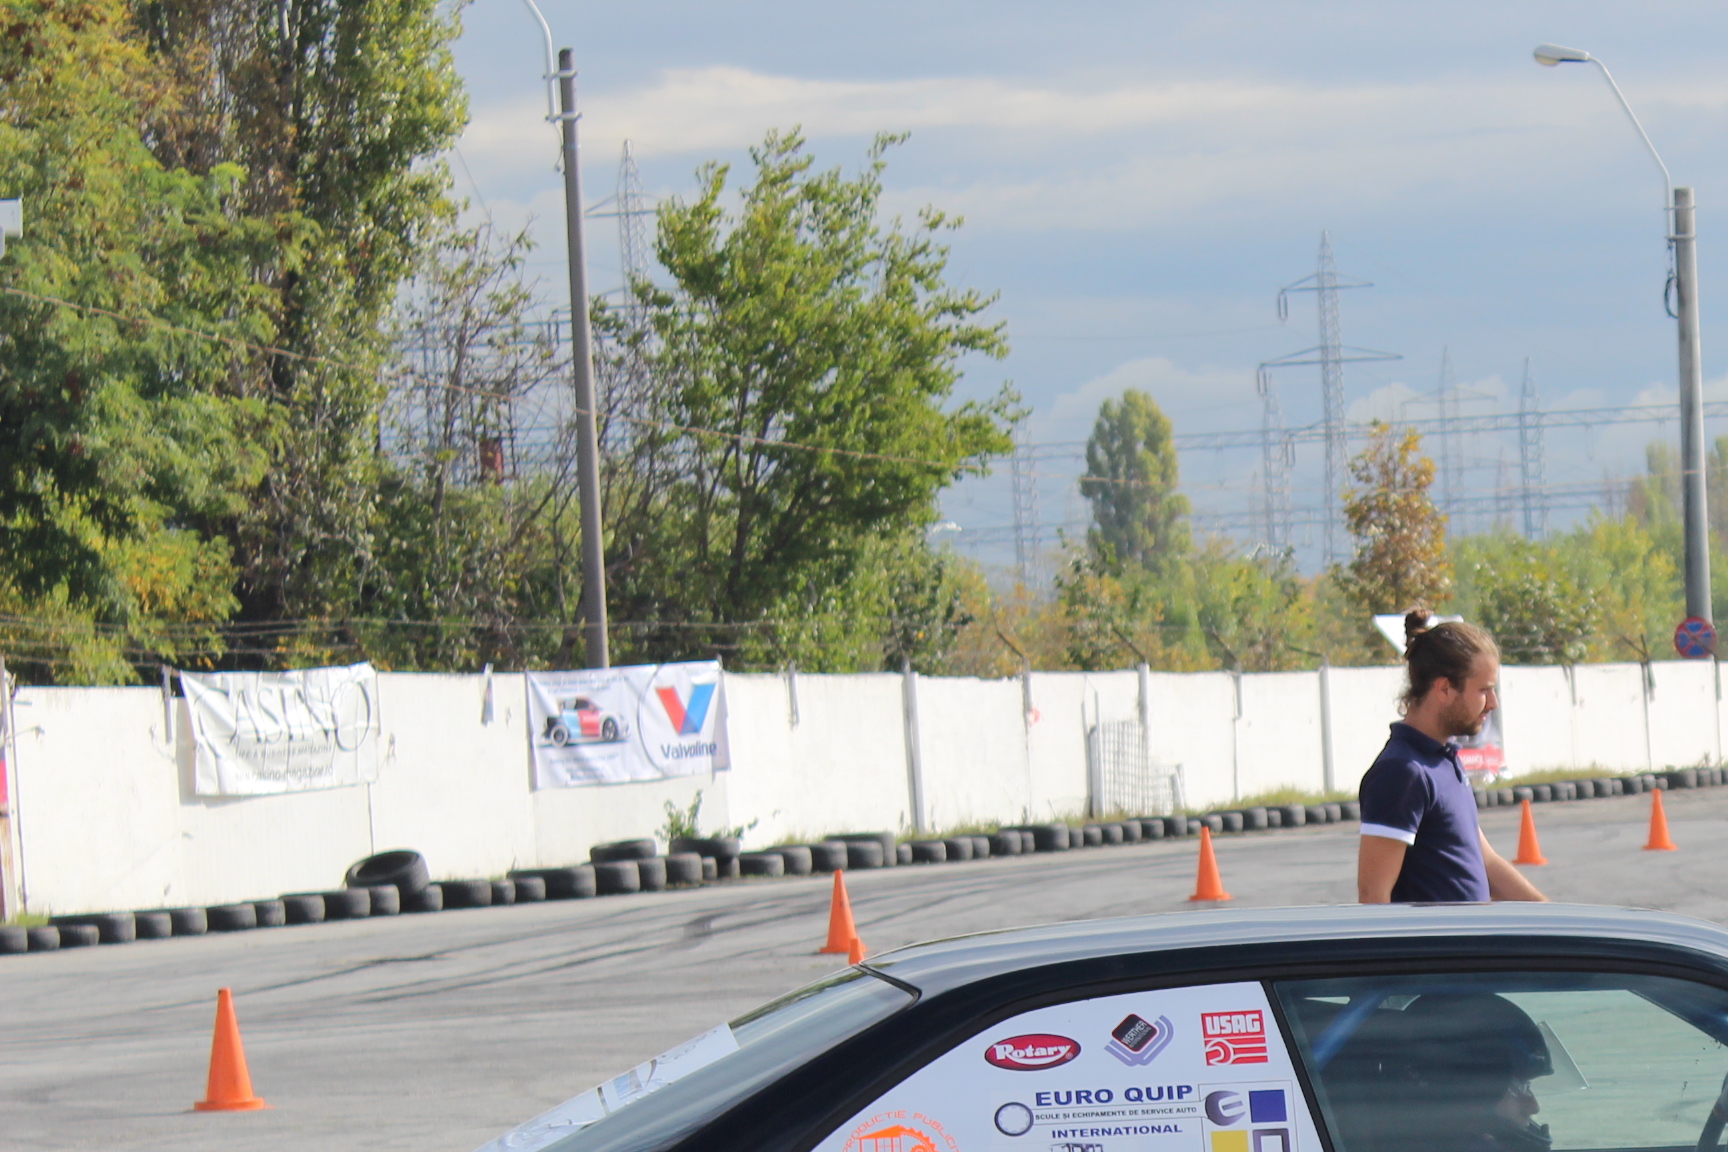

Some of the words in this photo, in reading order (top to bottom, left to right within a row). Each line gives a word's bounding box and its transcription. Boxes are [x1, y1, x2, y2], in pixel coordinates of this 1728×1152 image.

[195, 682, 372, 760] CASINO
[661, 741, 717, 760] Valvoline
[1205, 1014, 1261, 1035] USAG
[994, 1044, 1071, 1064] Rotary
[1035, 1088, 1114, 1107] EURO
[1124, 1085, 1193, 1103] QUIP
[1072, 1110, 1127, 1119] ECHIPAMENTE
[1129, 1109, 1139, 1117] DE
[1141, 1108, 1174, 1116] SERVICE
[1052, 1124, 1183, 1139] INTERNATIONAL
